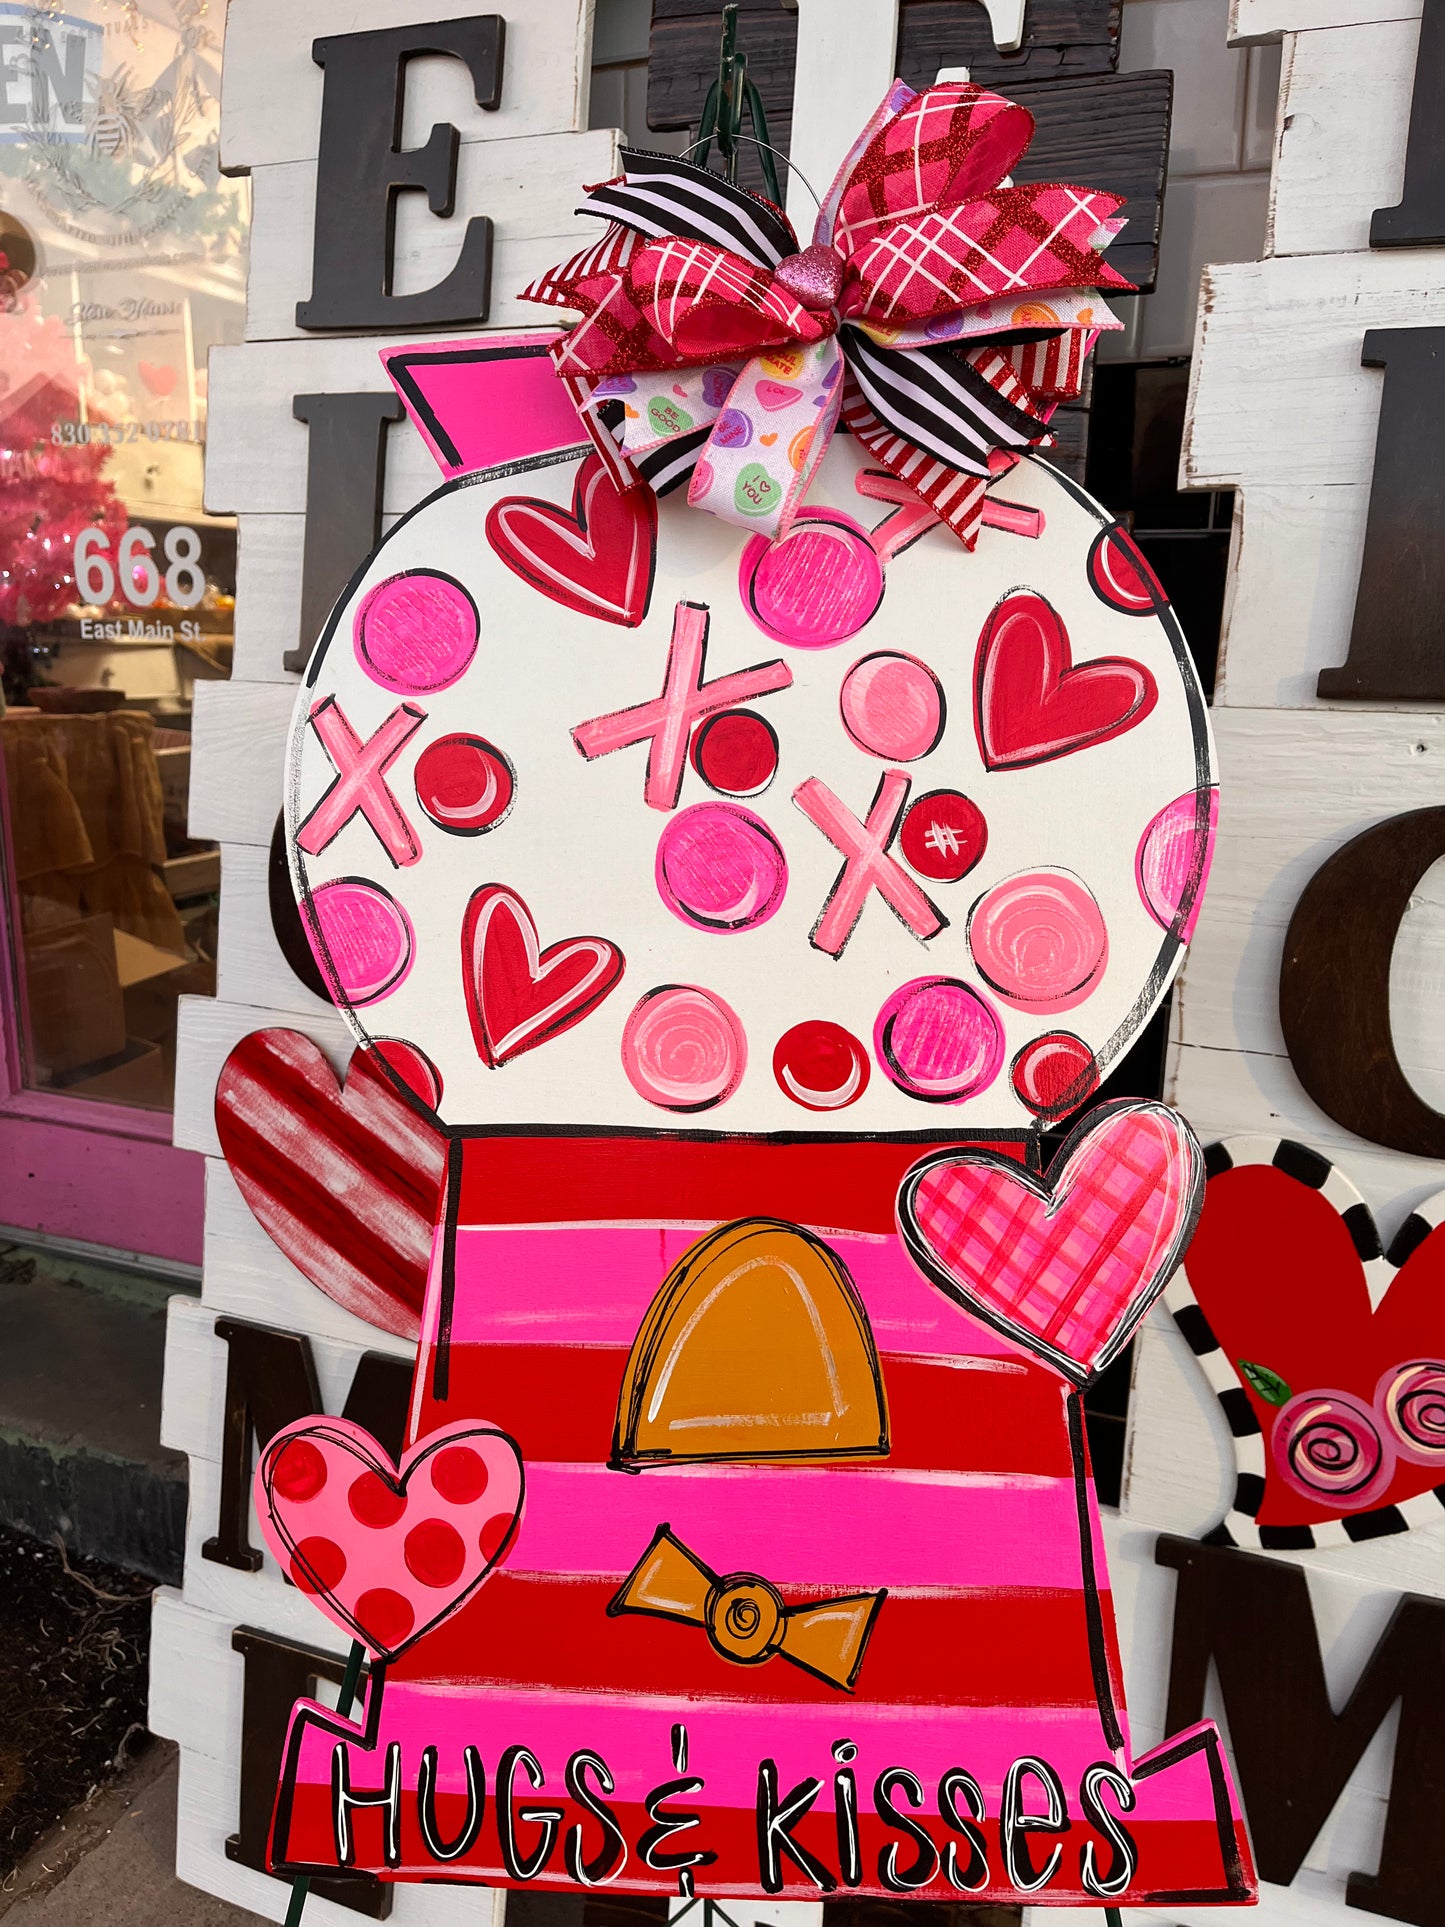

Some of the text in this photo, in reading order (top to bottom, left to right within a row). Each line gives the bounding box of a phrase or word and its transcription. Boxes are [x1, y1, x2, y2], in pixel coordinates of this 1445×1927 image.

[650, 407, 682, 434] GOOD
[663, 405, 679, 420] BE
[50, 422, 92, 446] 830
[98, 421, 140, 445] 352
[719, 425, 745, 444] MINE
[742, 480, 763, 505] YOU
[73, 525, 206, 608] 668
[79, 618, 122, 640] East
[128, 619, 174, 641] Main
[331, 1740, 629, 1888] HUGS
